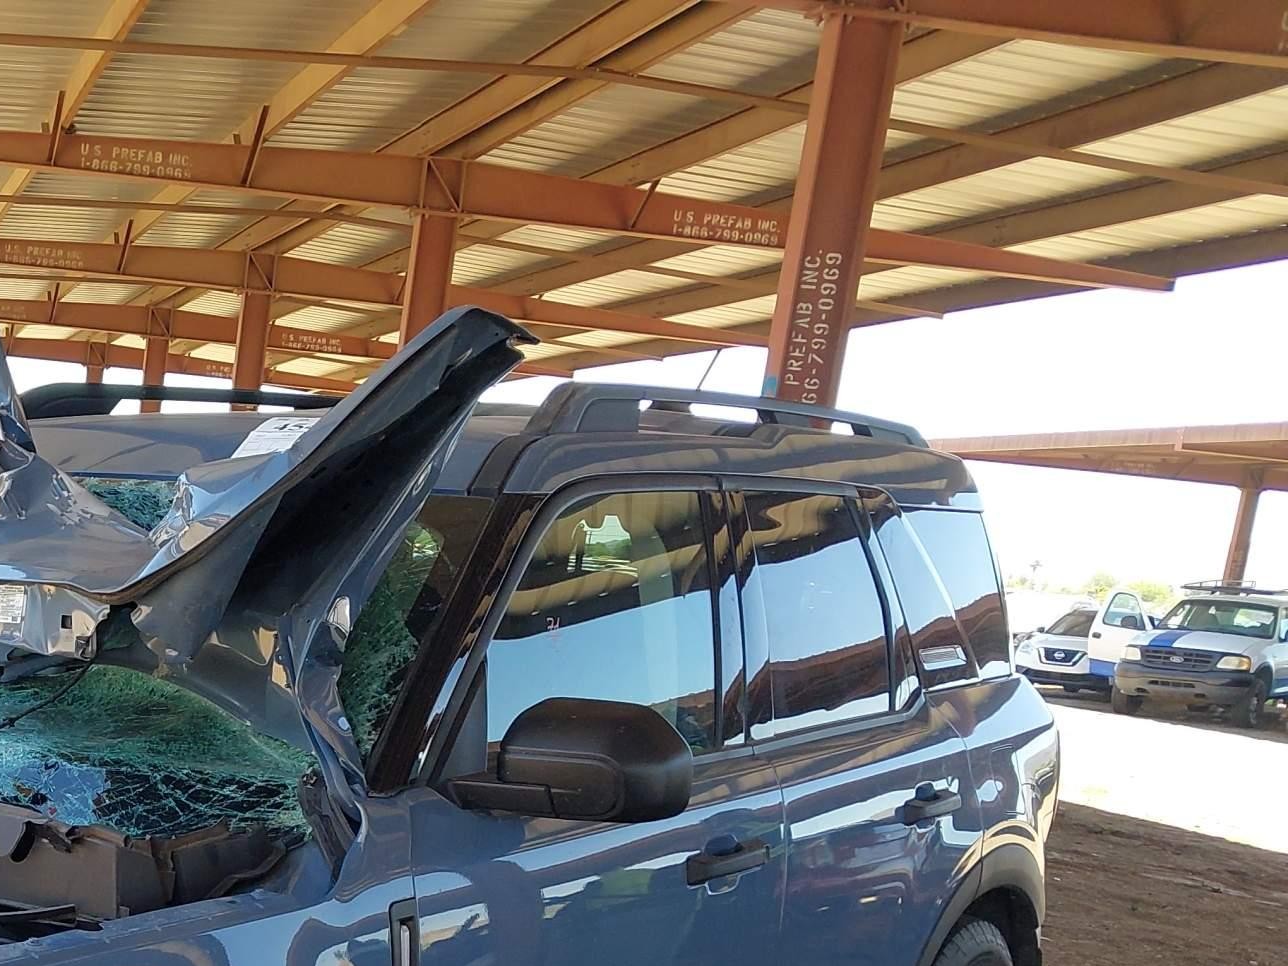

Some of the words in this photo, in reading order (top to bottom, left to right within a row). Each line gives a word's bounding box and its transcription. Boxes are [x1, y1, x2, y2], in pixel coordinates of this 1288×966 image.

[112, 147, 163, 164] PREFAB
[169, 153, 193, 167] INC.
[704, 213, 752, 229] PREFAB
[758, 219, 781, 233] INC.
[784, 302, 813, 385] PREFAB
[800, 250, 823, 290] INC.
